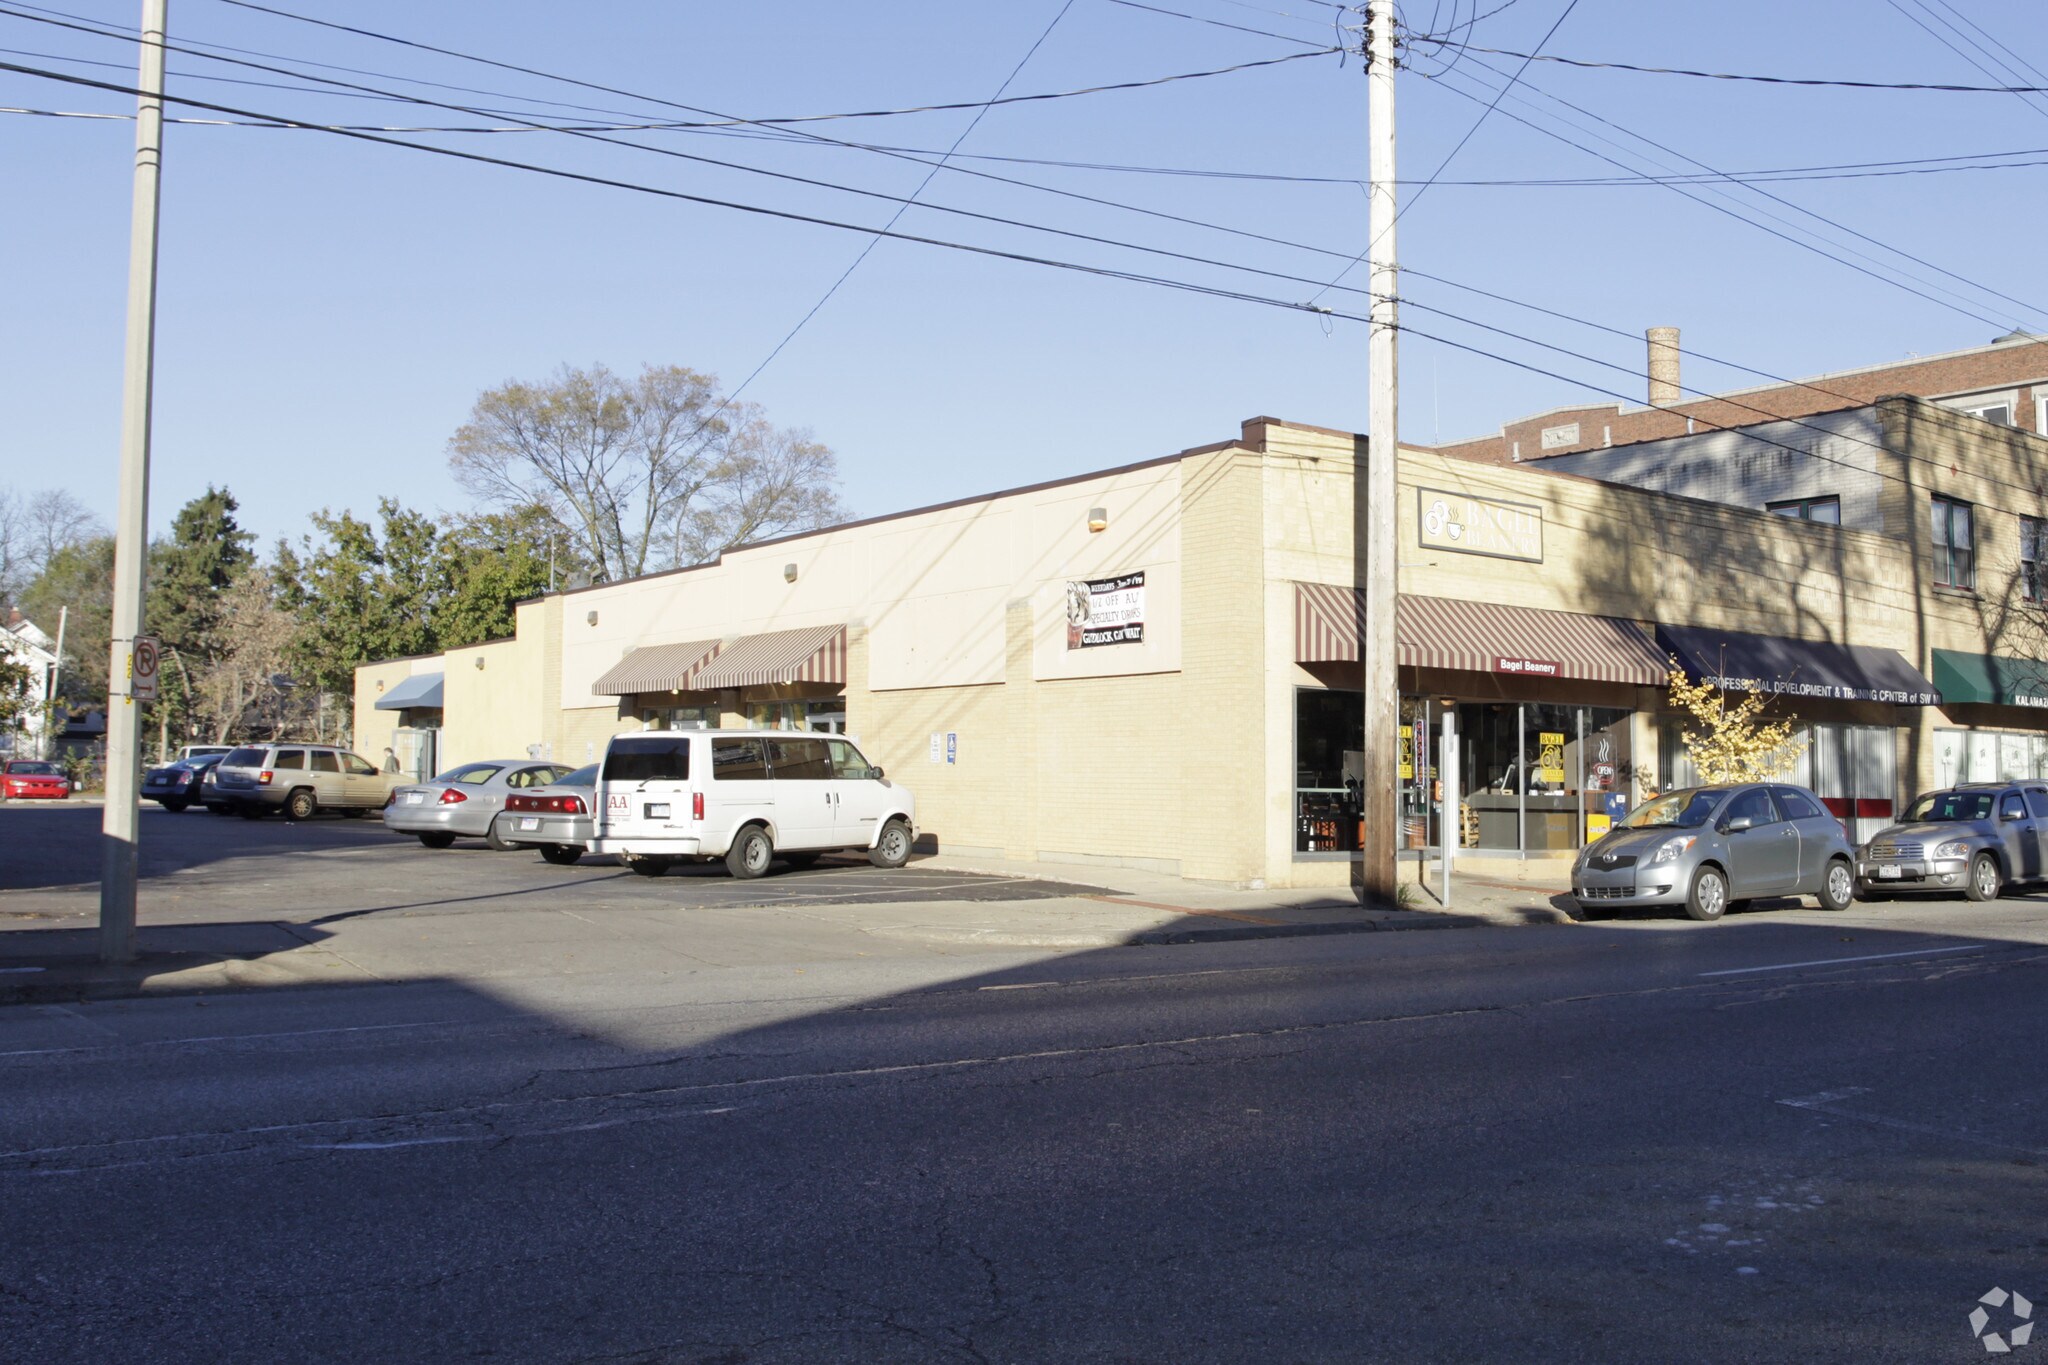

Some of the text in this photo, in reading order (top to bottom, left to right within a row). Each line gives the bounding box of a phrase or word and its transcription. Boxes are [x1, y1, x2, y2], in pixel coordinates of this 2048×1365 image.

[1467, 501, 1539, 535] BAGEL
[1466, 530, 1538, 555] BEANERY
[1105, 594, 1119, 607] OFF
[1500, 658, 1556, 675] Bagel Beanery
[1773, 681, 1832, 697] DEVELOPMENT
[1834, 686, 1841, 698] &
[1843, 687, 1877, 700] TRAINING
[1879, 690, 1908, 703] CENTER
[1919, 692, 1932, 704] SW
[2015, 694, 2048, 709] KALAMAZ
[1597, 765, 1612, 775] OPEN
[608, 796, 628, 809] AA
